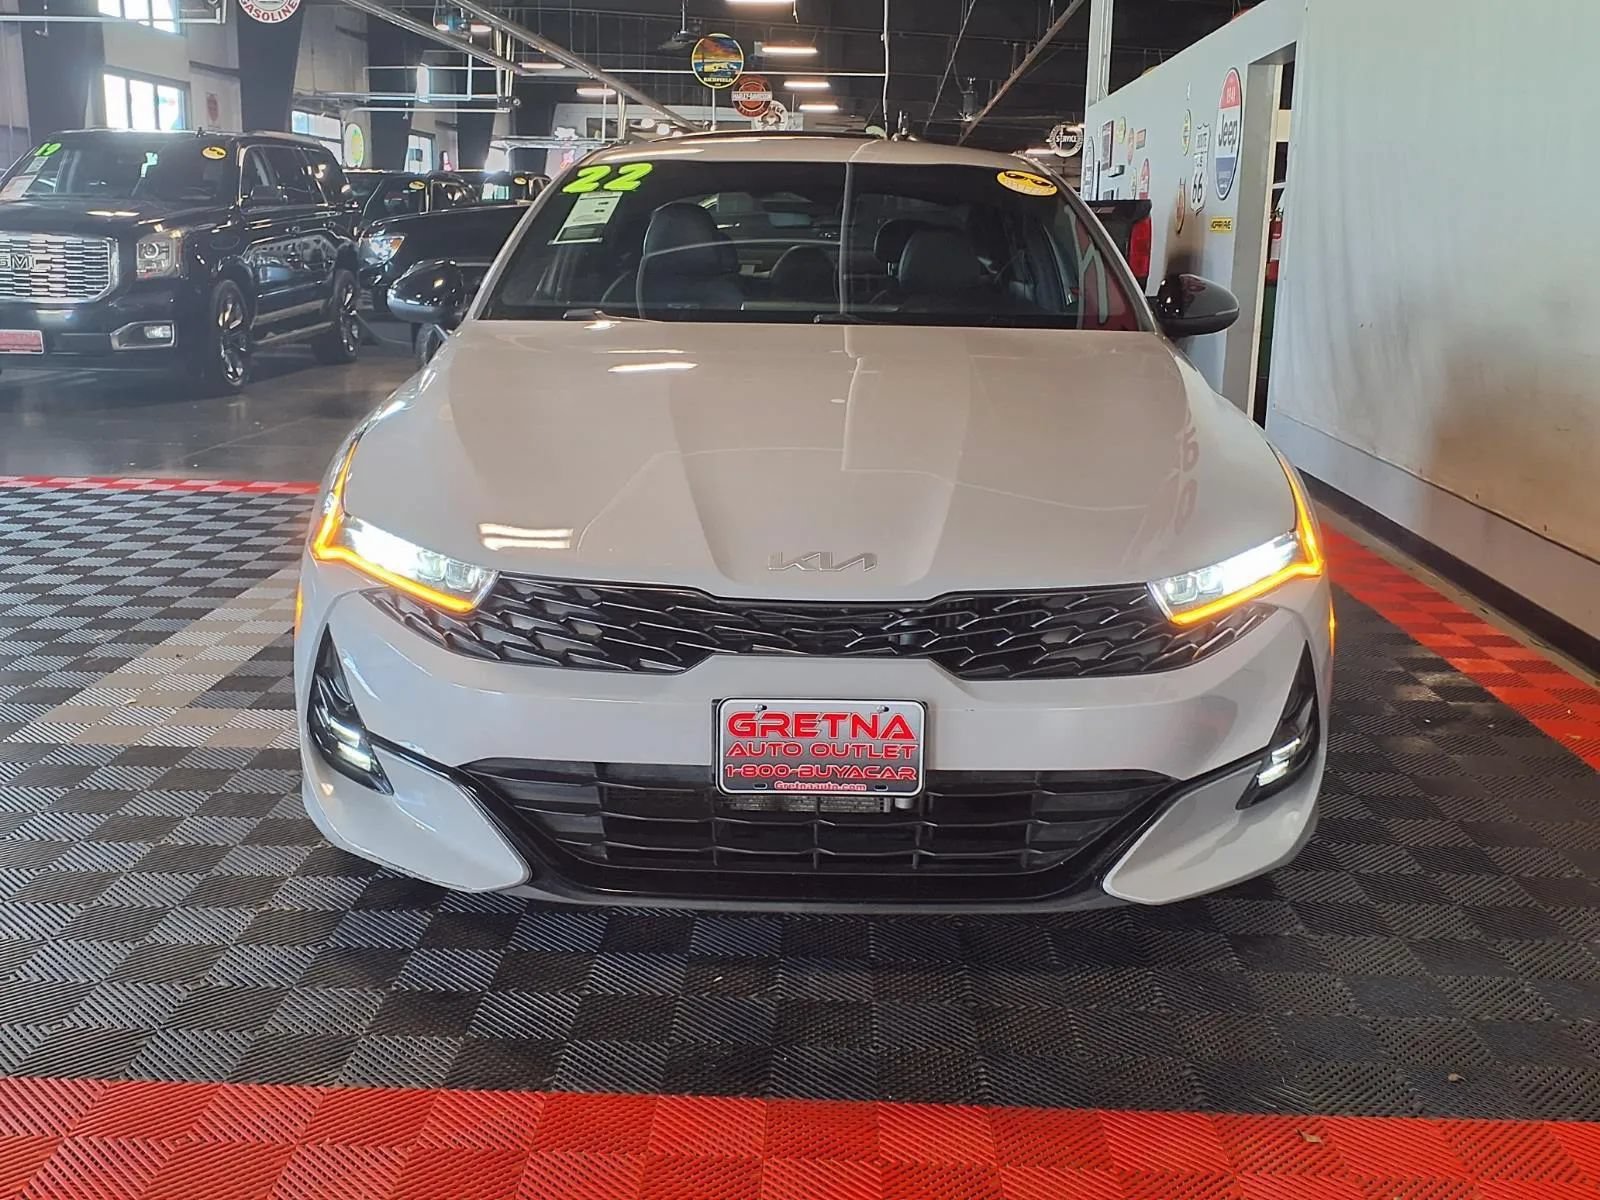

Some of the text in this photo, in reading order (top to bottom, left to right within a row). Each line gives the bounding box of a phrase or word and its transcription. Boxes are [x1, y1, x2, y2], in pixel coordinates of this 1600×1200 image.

[1218, 114, 1237, 152] Jeep
[34, 142, 62, 157] 19
[561, 161, 654, 194] 22
[1192, 171, 1203, 203] 66
[767, 551, 877, 572] KIA
[727, 712, 917, 740] GRETNA
[725, 741, 918, 760] AUTO OUTLET
[724, 764, 917, 781] 1-800-BUYACAR
[774, 780, 867, 792] Gretnaauto.com
